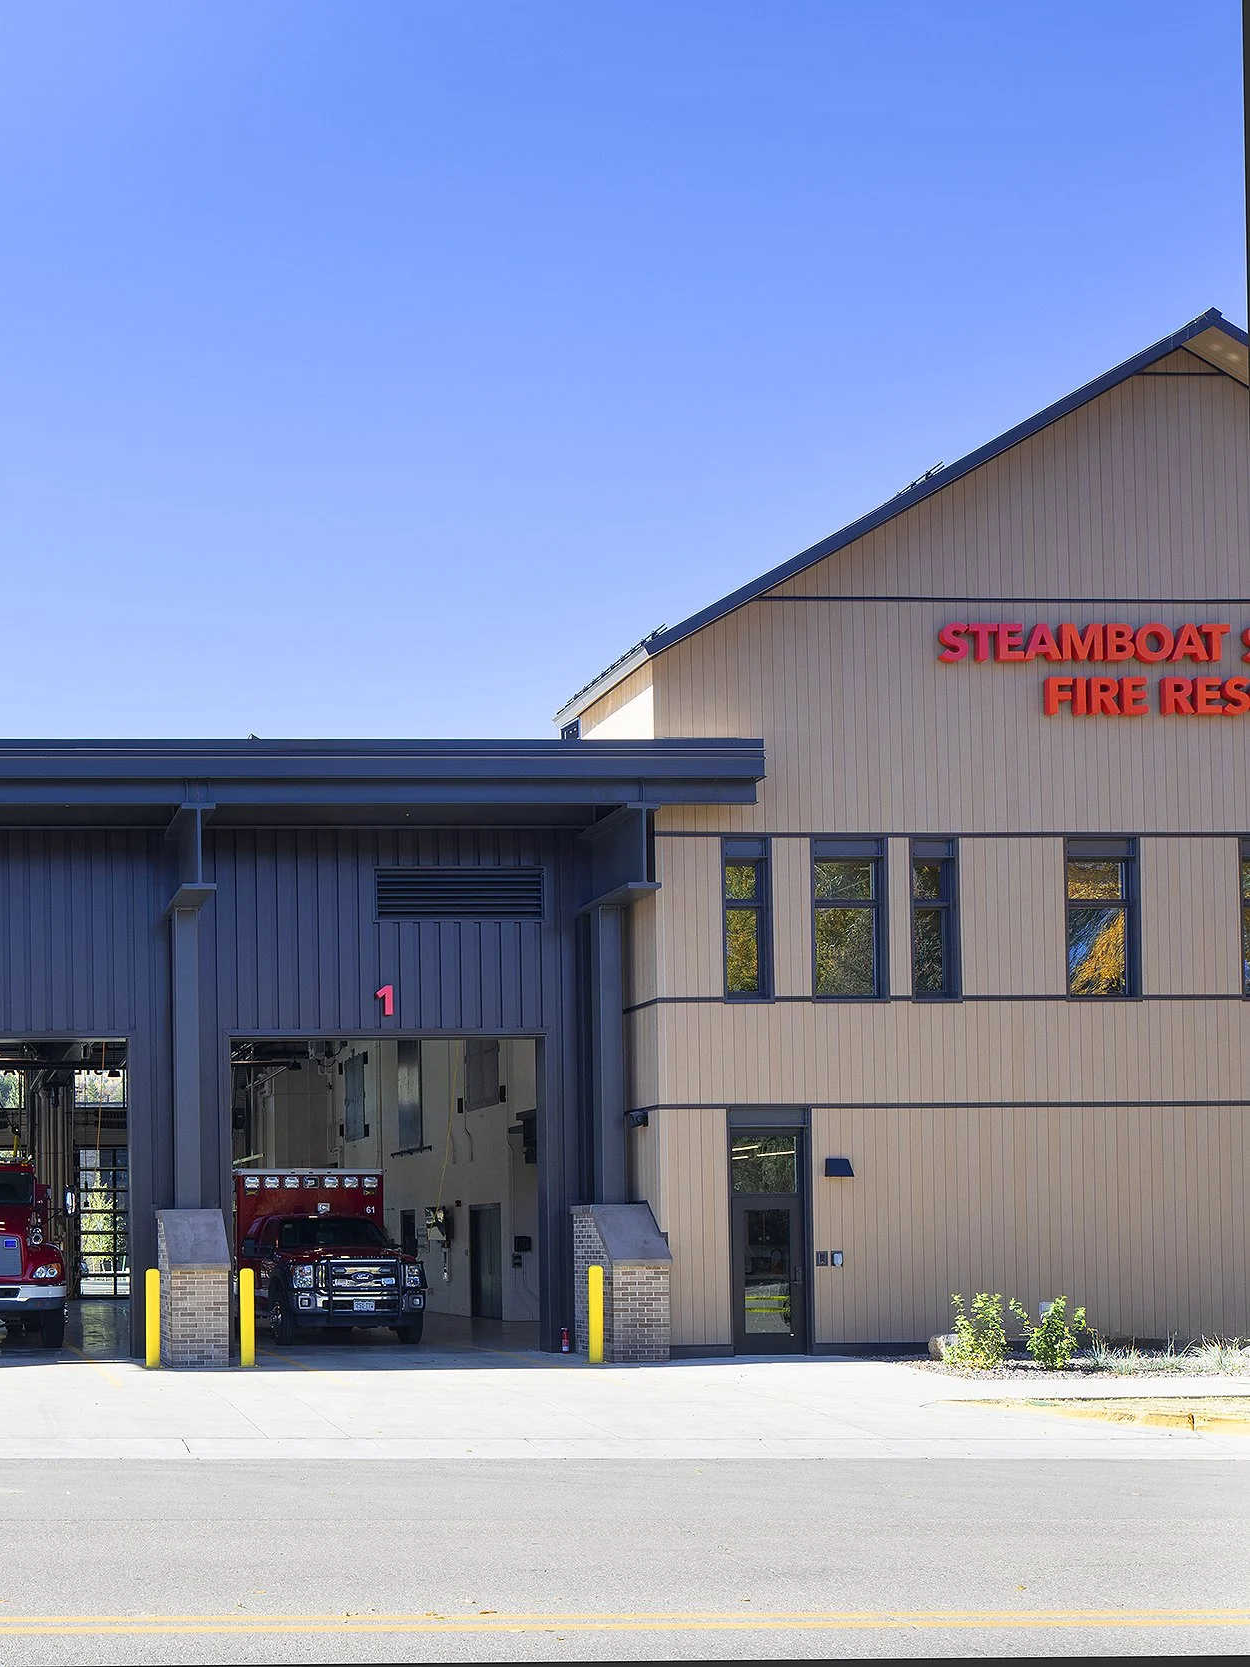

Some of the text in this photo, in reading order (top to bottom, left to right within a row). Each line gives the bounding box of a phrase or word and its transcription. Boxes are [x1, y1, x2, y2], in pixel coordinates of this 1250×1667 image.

[938, 622, 1230, 663] STEAMBOAT
[1044, 676, 1250, 716] FIRE RES
[375, 985, 393, 1016] 1
[365, 1205, 375, 1214] 61
